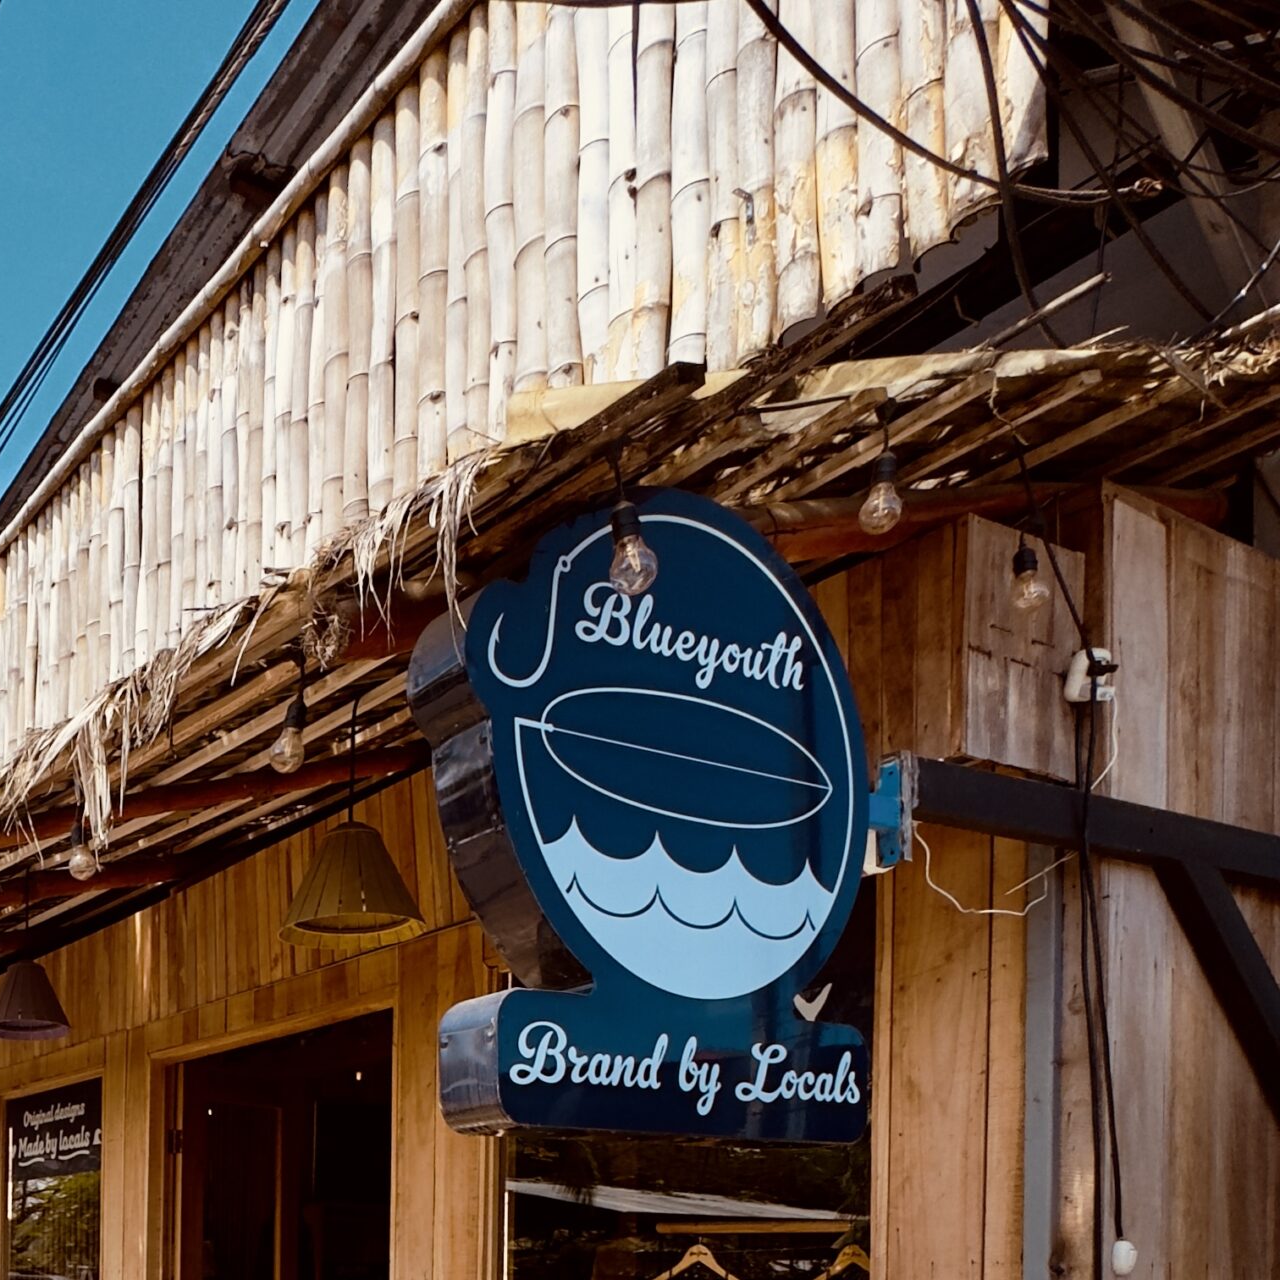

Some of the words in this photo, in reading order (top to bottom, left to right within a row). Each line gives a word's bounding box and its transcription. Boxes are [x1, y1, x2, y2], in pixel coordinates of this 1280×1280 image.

[574, 582, 805, 691] Blueyouth
[509, 1021, 668, 1090] Brand
[679, 1035, 722, 1116] by
[734, 1042, 861, 1105] Locals
[18, 1134, 45, 1159] Made
[45, 1132, 58, 1160] by
[58, 1125, 91, 1151] locals
[23, 1104, 54, 1131] Original
[54, 1102, 86, 1123] designs
